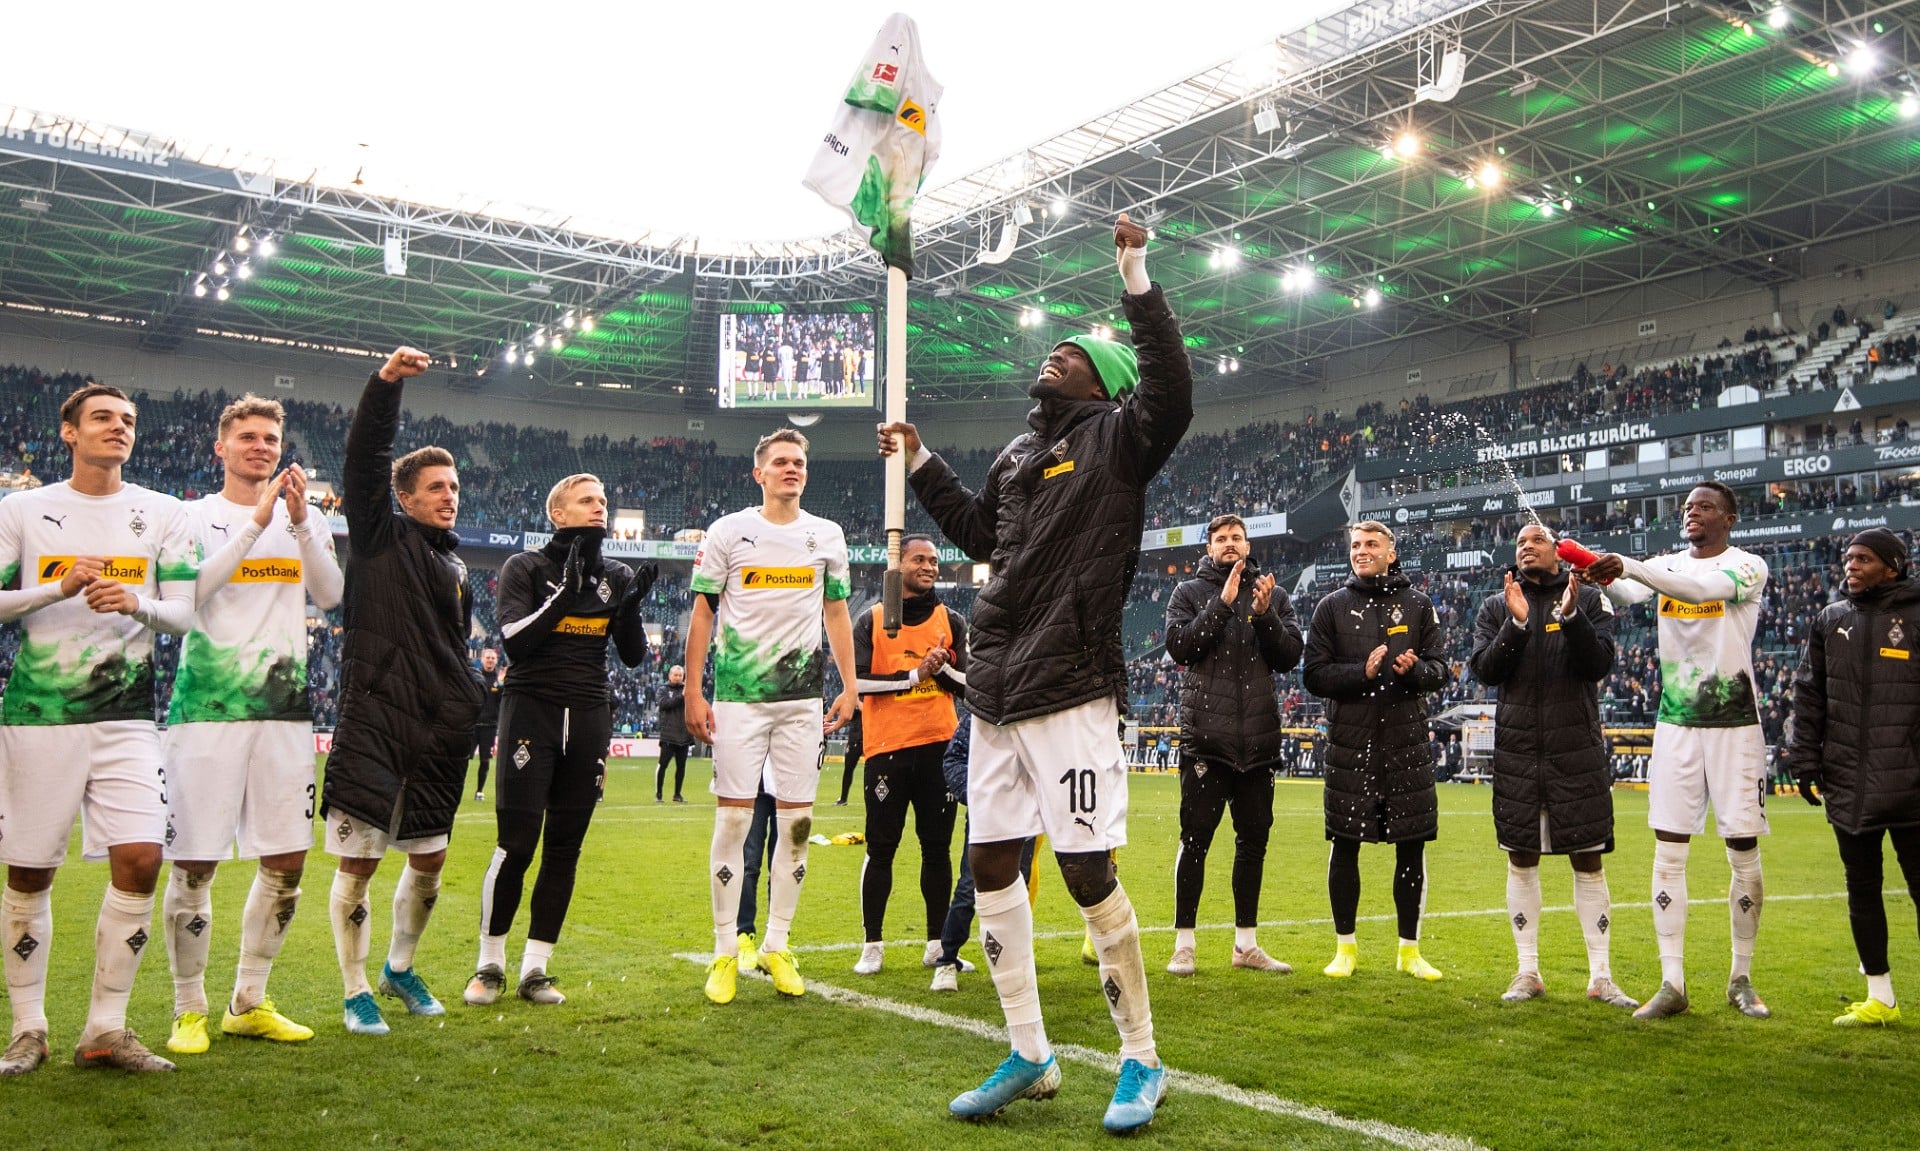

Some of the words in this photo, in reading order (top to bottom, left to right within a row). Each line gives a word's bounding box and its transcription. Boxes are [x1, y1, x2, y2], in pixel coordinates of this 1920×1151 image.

[1478, 442, 1538, 463] STOLZER
[1541, 433, 1586, 451] BLICK
[1589, 422, 1656, 446] ZURÜCK.
[1783, 455, 1831, 476] ERGO
[1714, 467, 1758, 481] Sonepar
[1848, 515, 1887, 528] Postbank
[489, 533, 519, 545] DSV
[607, 542, 647, 553] ONLINE
[1447, 550, 1481, 568] PUMA
[242, 565, 299, 578] Postbank
[765, 574, 814, 585] Postbank
[1677, 602, 1723, 614] Postbank
[1060, 768, 1096, 813] 10
[1758, 777, 1765, 808] 8
